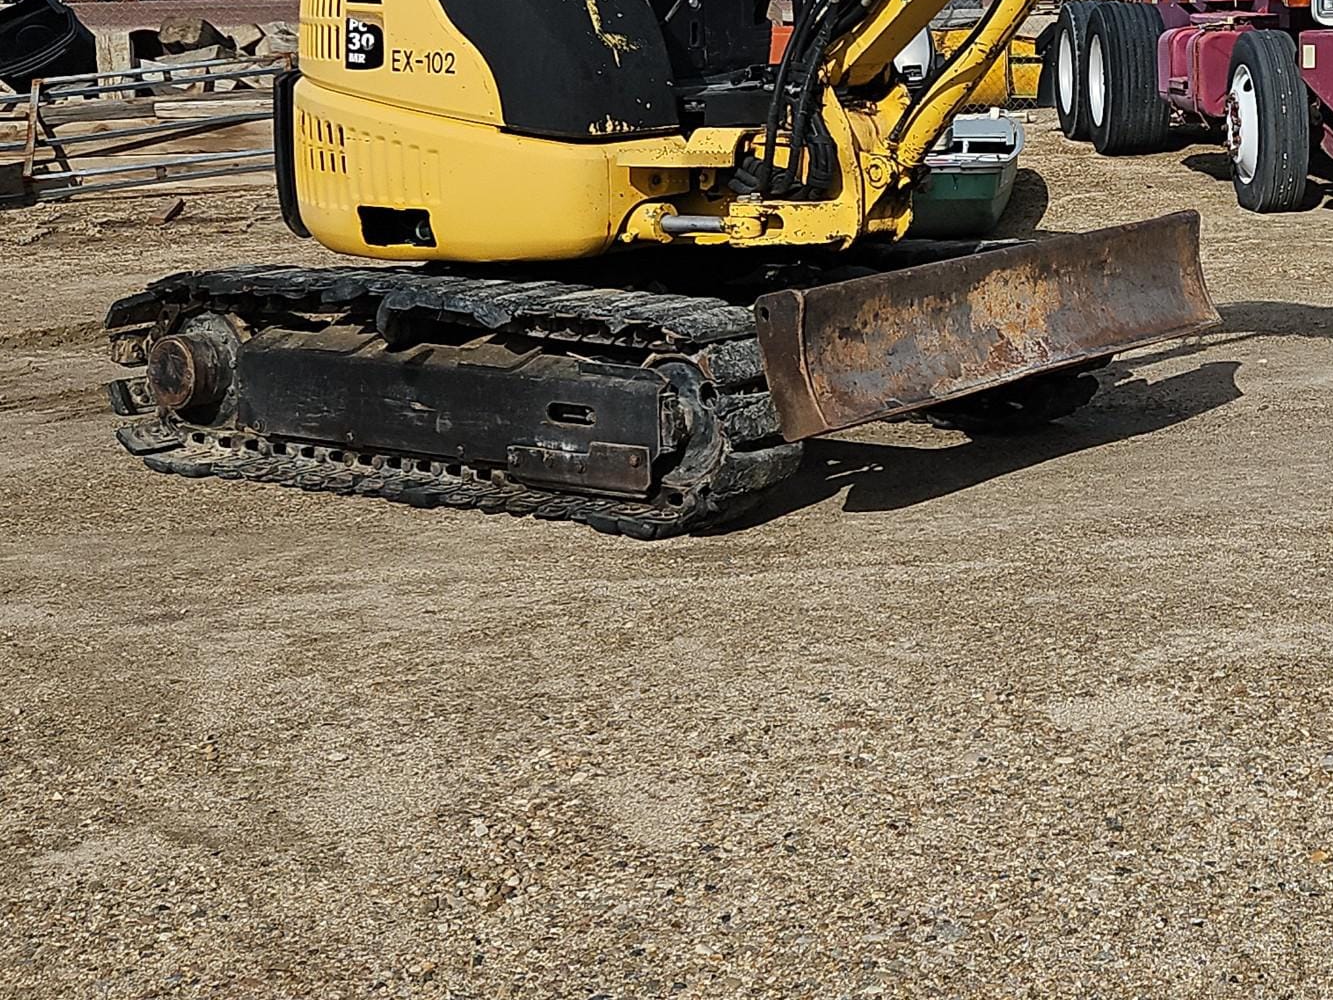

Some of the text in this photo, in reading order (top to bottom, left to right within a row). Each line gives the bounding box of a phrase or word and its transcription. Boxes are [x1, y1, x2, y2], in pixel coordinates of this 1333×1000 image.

[348, 18, 368, 32] PC
[348, 33, 375, 50] 30
[348, 53, 366, 63] MR
[391, 49, 455, 74] EX-102
